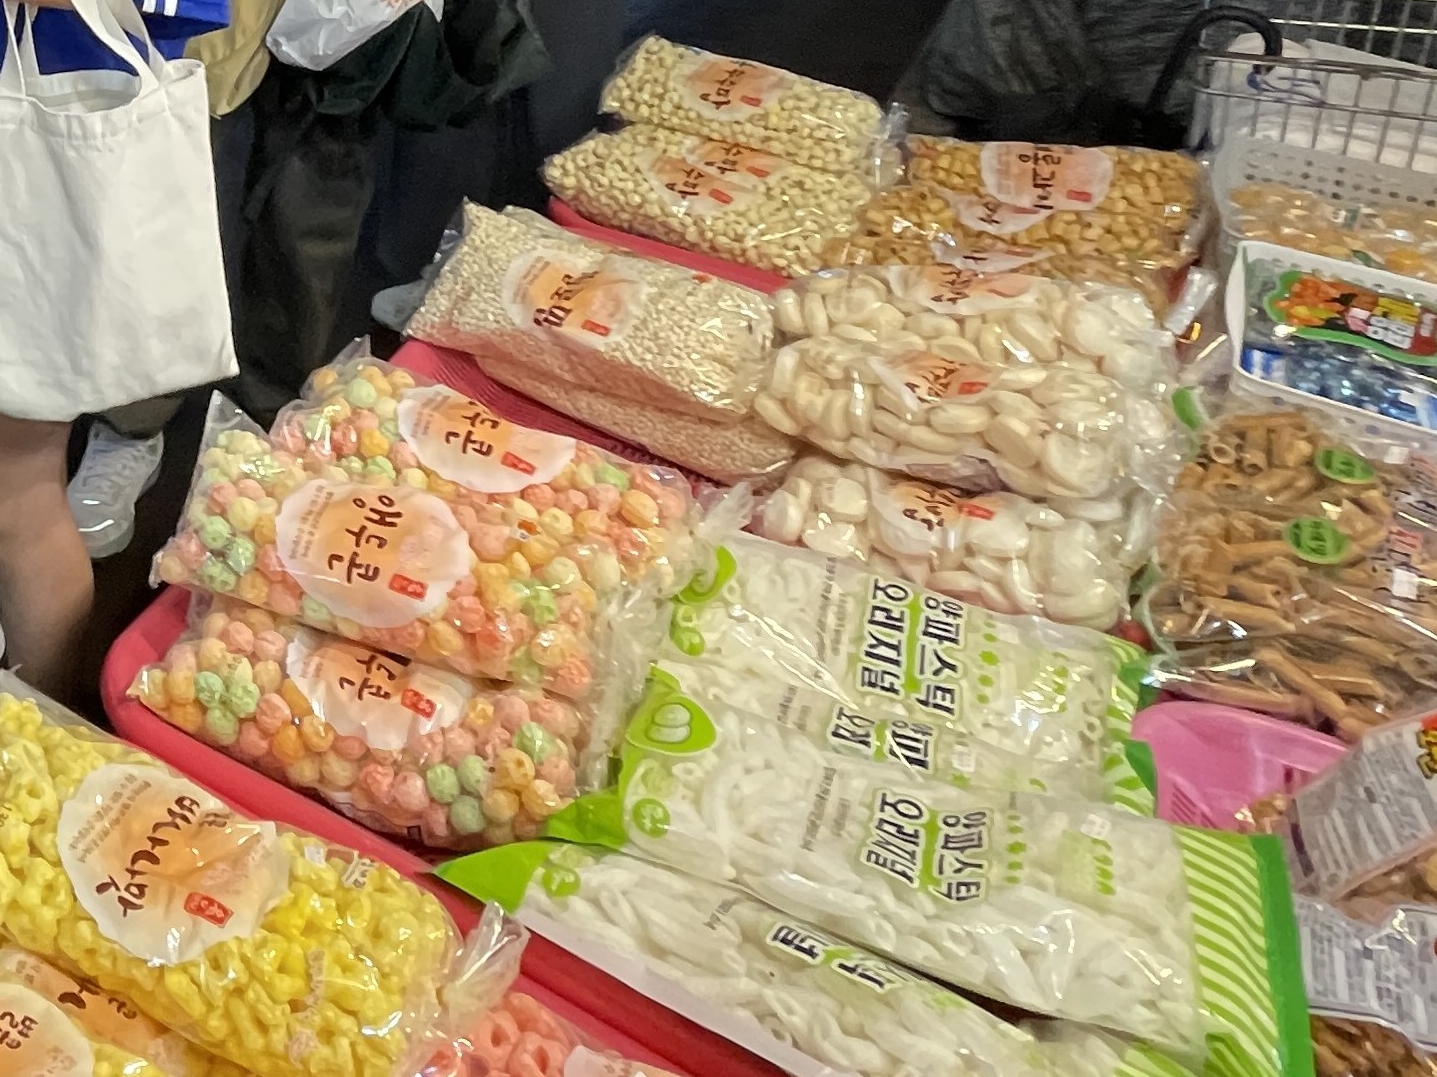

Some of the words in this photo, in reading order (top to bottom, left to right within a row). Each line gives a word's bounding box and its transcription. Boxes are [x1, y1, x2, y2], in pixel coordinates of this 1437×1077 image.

[444, 401, 501, 457] 두콘
[327, 494, 403, 584] 앵두콘
[338, 649, 412, 701] 두콘
[861, 577, 910, 696] 오리지널
[915, 595, 965, 716] 양파스틱
[95, 795, 201, 918] 바나나맛
[866, 792, 924, 885] 오리지널
[931, 810, 987, 902] 양파스틱
